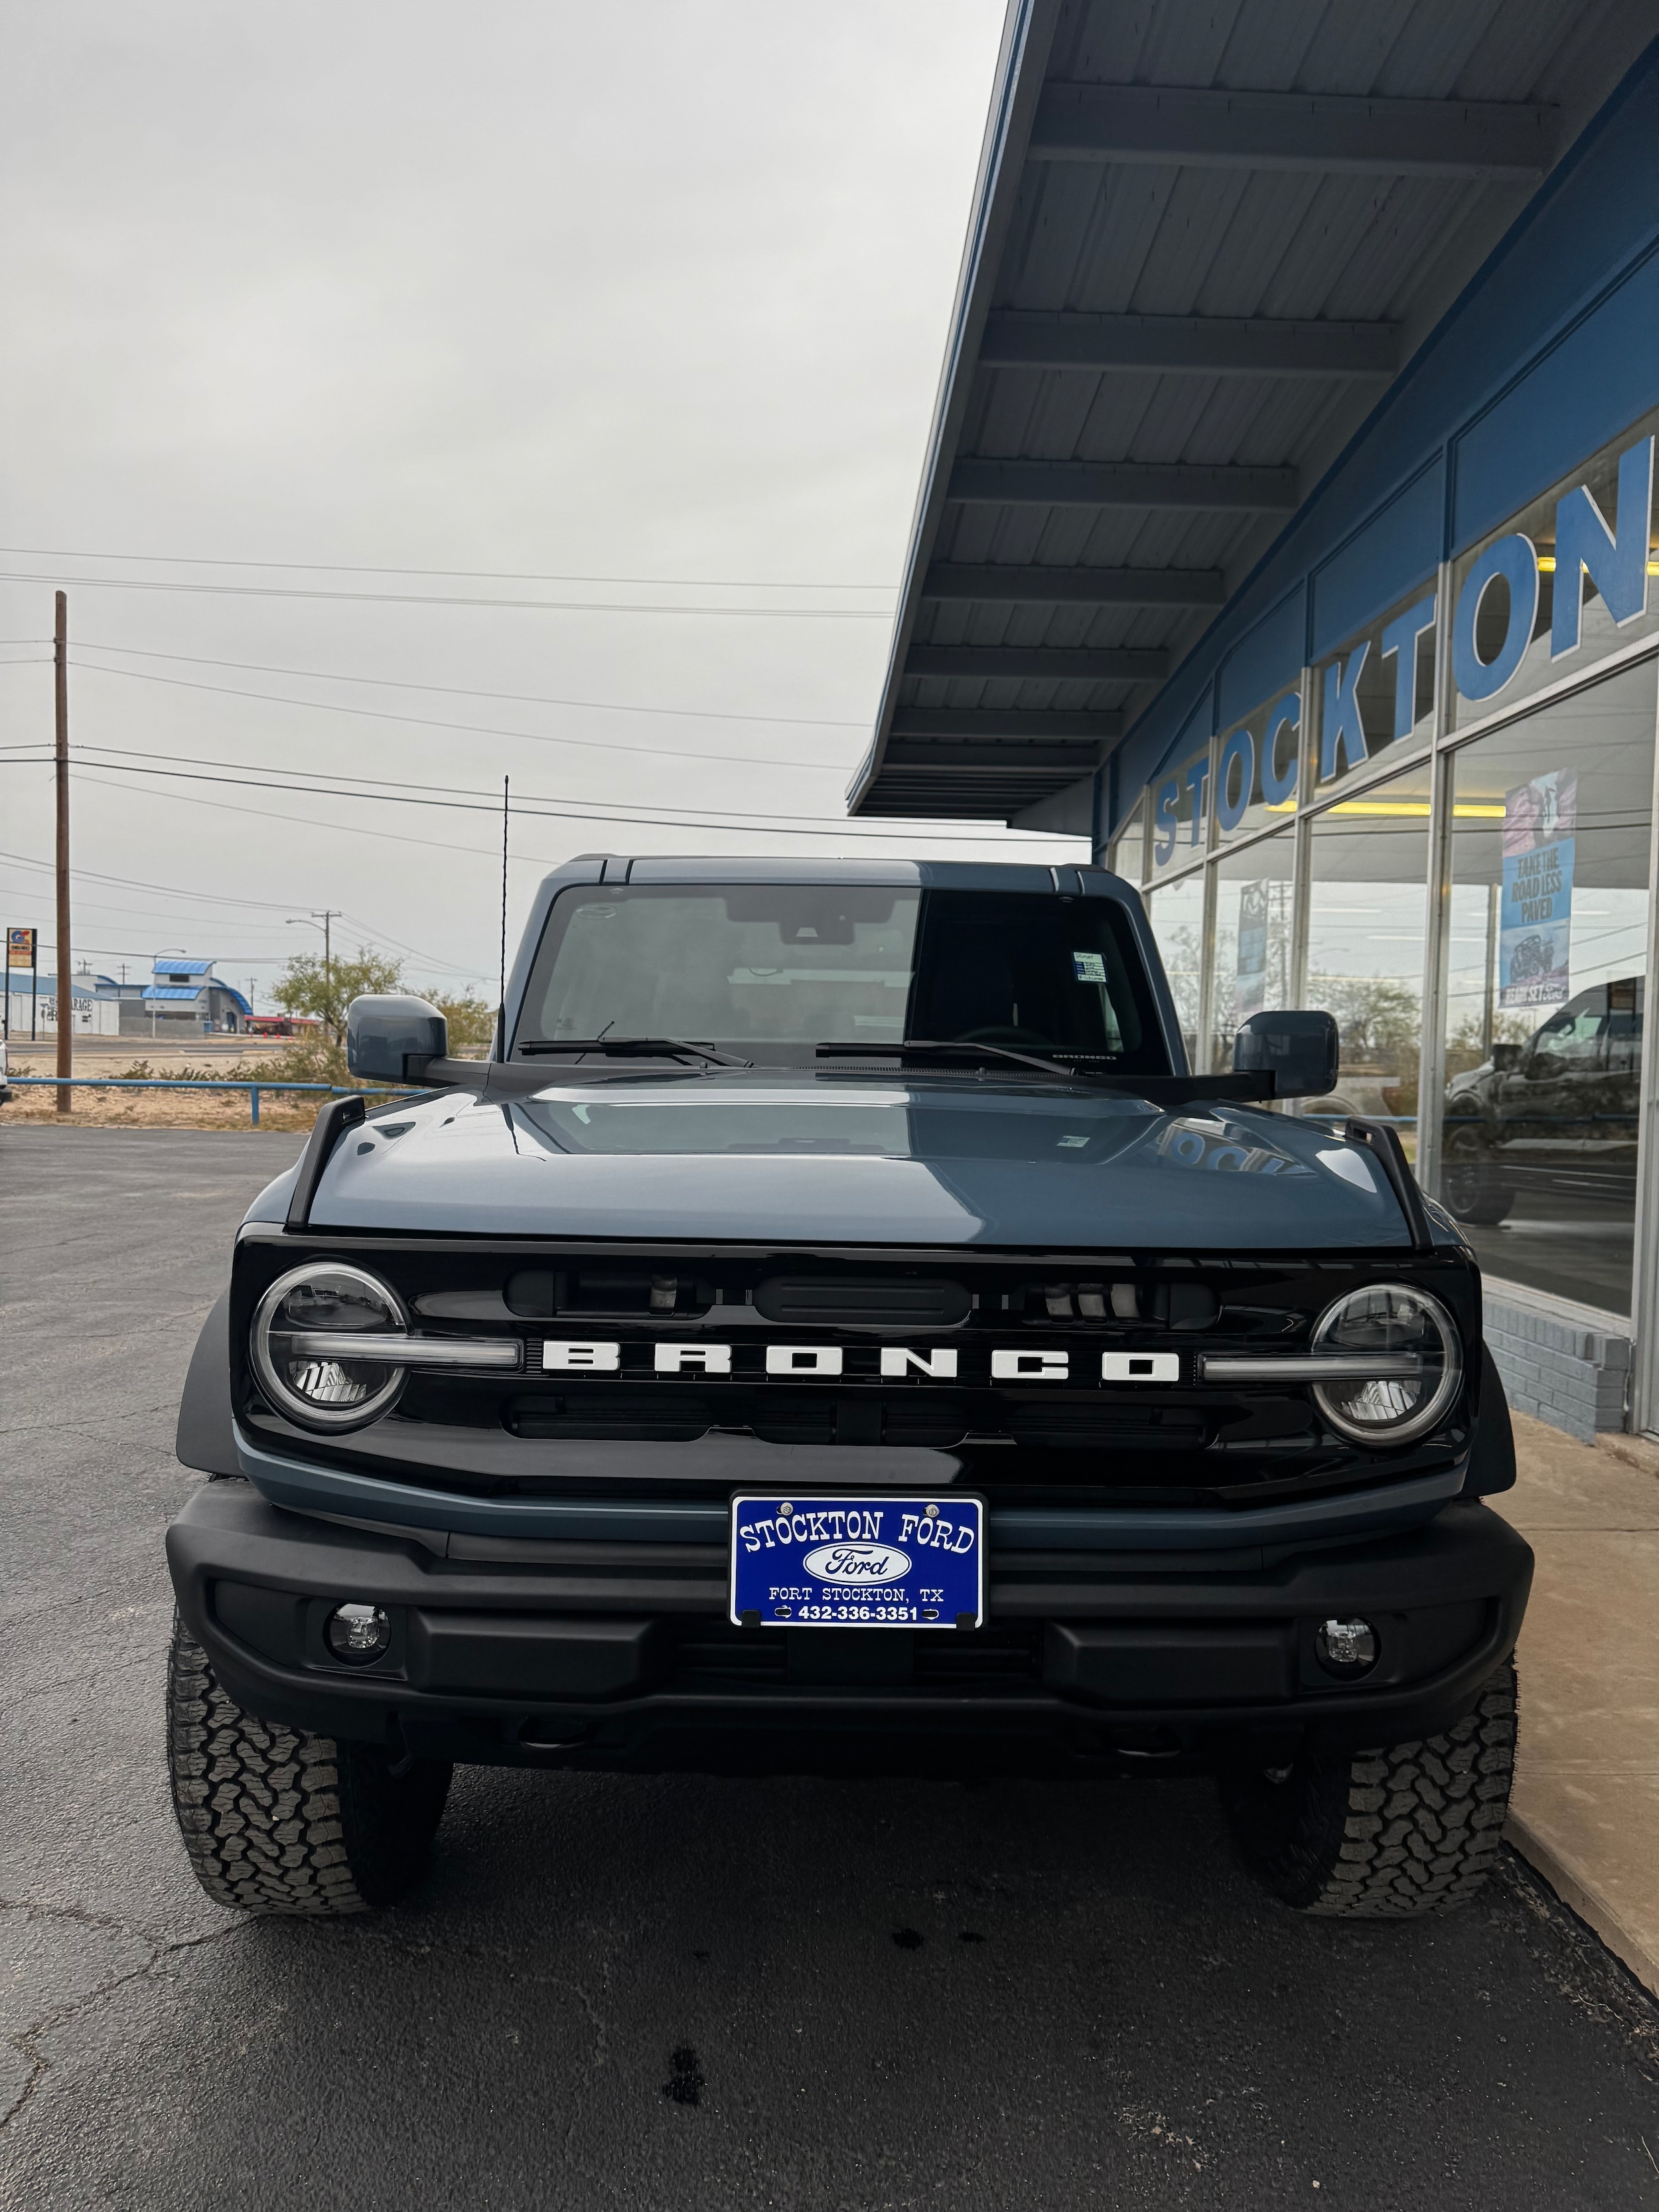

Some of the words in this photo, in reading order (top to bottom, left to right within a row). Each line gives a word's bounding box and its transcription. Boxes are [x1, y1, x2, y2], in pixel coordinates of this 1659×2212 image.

[1154, 433, 1656, 867] STOCKTON
[1517, 852, 1542, 879] TAKE
[1542, 847, 1559, 872] THE
[1512, 877, 1540, 903] ROAD
[1541, 869, 1562, 897] LESS
[1521, 897, 1552, 924] PAVED
[71, 997, 93, 1011] RAGE
[542, 1341, 1180, 1382] BRONCO
[739, 1511, 884, 1553] STOCKTON
[898, 1514, 975, 1554] FORD
[825, 1548, 889, 1576] Ford
[768, 1587, 813, 1601] FORT
[822, 1587, 909, 1604] STOCKTON,
[920, 1589, 944, 1602] TX
[798, 1605, 918, 1621] 432-336-3351
